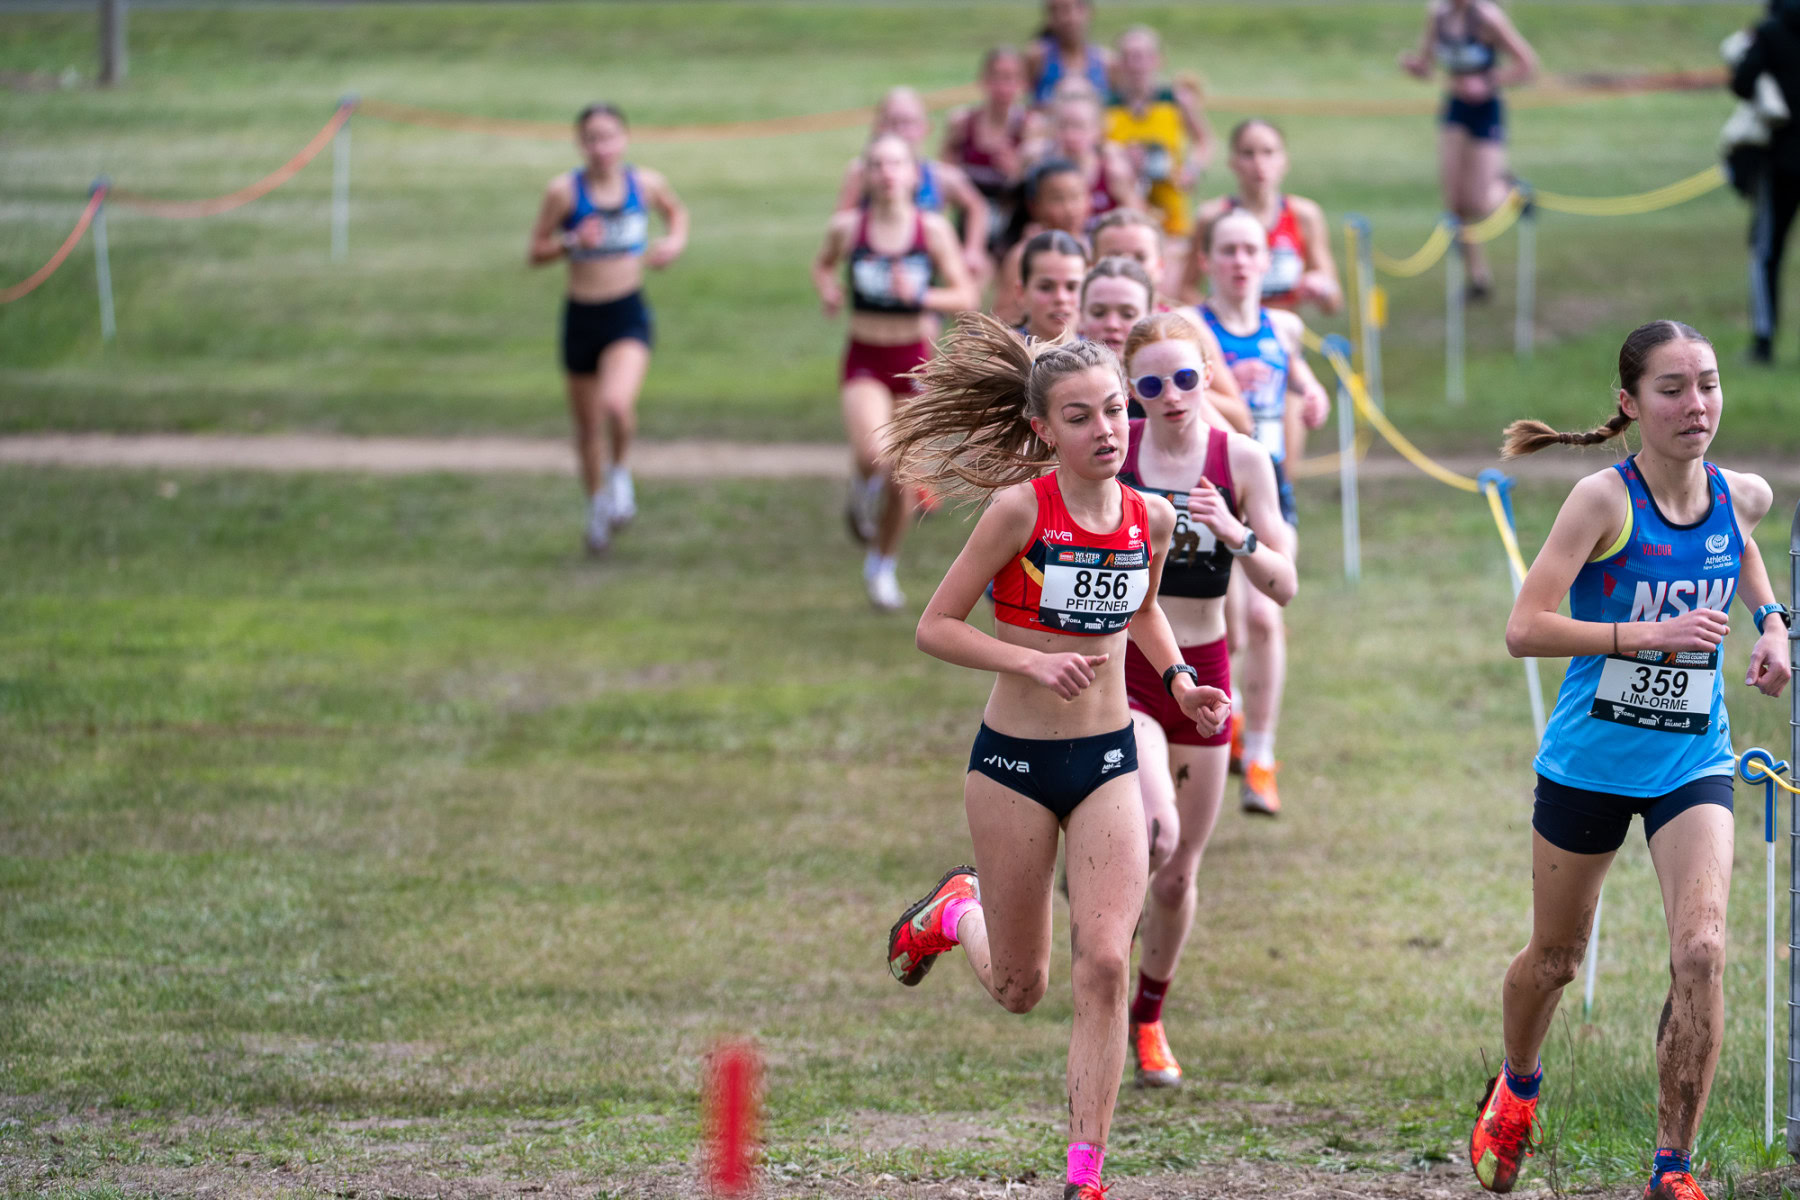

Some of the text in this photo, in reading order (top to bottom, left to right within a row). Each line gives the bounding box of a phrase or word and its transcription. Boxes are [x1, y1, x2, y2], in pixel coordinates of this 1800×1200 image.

[1075, 551, 1100, 560] WINTER
[1642, 543, 1672, 556] VALOUR
[1704, 553, 1732, 565] Athletics
[1073, 570, 1129, 600] 856
[1065, 598, 1129, 611] PFITZNER
[1629, 577, 1735, 622] NSW
[1084, 622, 1102, 630] PUMA
[1631, 666, 1689, 698] 359
[1620, 691, 1689, 711] LIN-ORME
